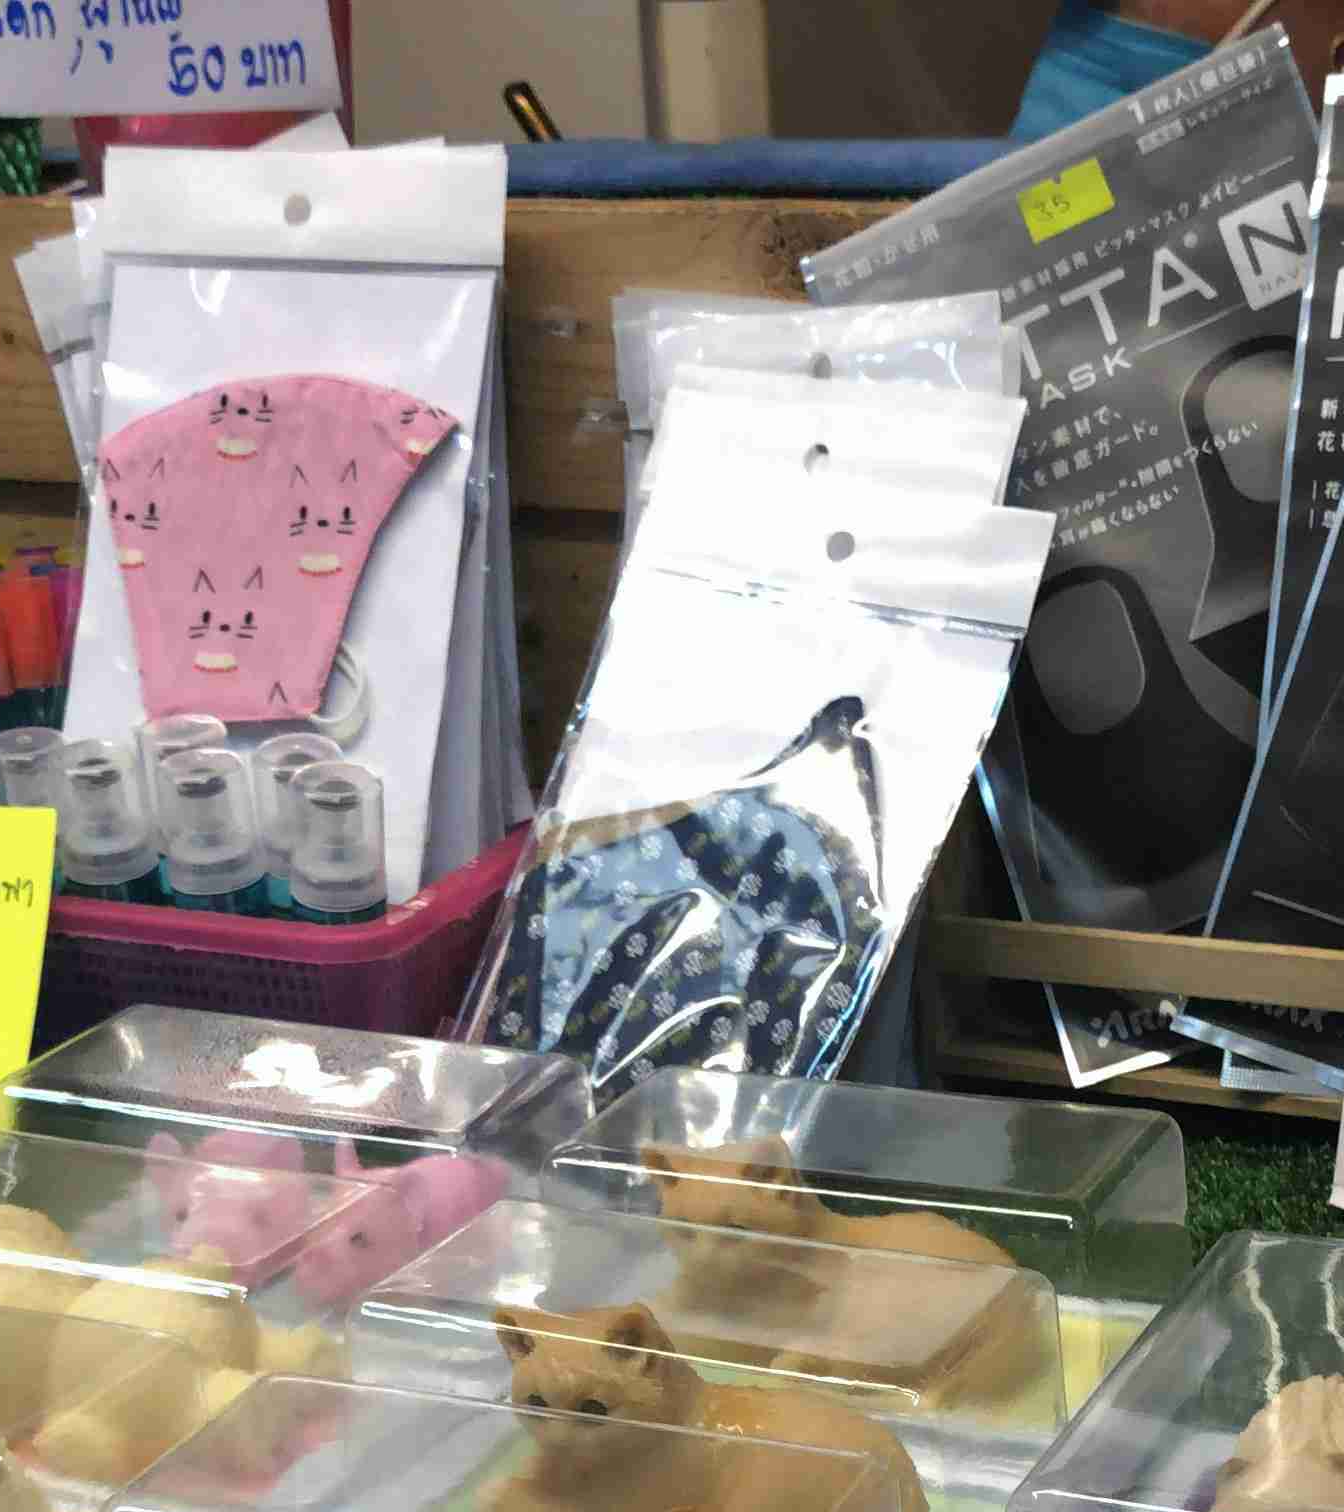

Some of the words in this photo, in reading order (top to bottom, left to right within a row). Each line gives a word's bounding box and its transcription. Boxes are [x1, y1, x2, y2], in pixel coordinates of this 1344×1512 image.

[1001, 246, 1219, 381] TTA
[1237, 200, 1308, 276] N
[1026, 346, 1134, 415] ASK
